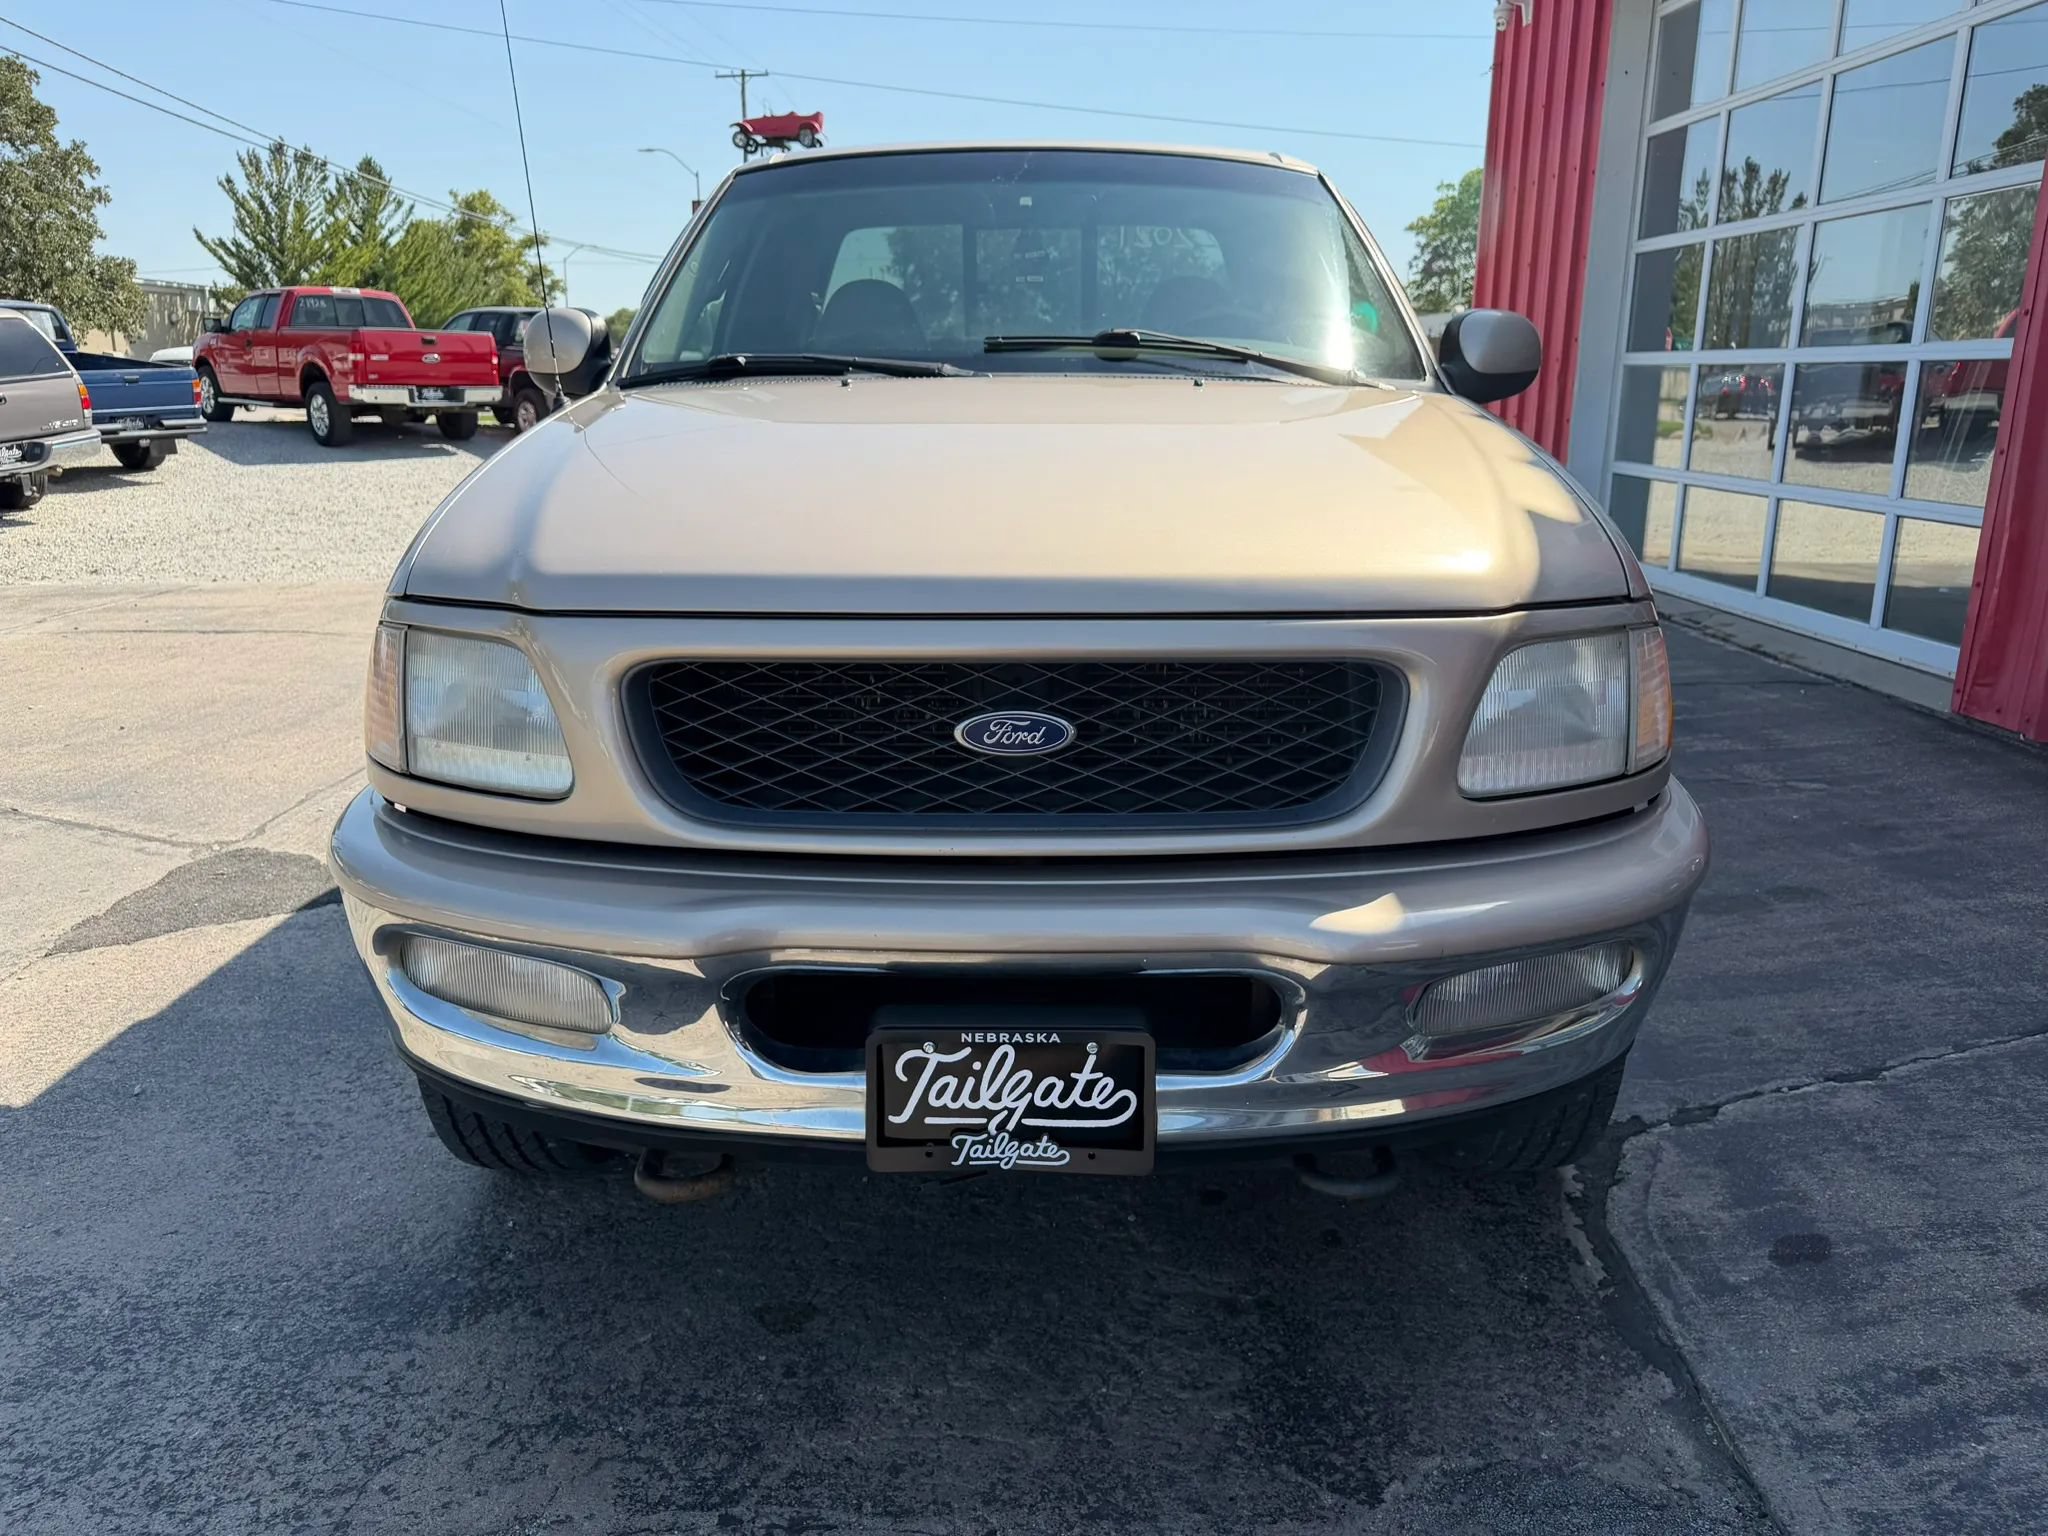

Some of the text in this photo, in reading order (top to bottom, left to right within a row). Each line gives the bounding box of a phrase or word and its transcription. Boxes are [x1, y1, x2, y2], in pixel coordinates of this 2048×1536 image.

[983, 719, 1047, 745] Ford
[960, 1032, 1061, 1043] NEBRASKA
[888, 1044, 1137, 1135] Tailgate
[951, 1132, 1070, 1169] Tailgate
